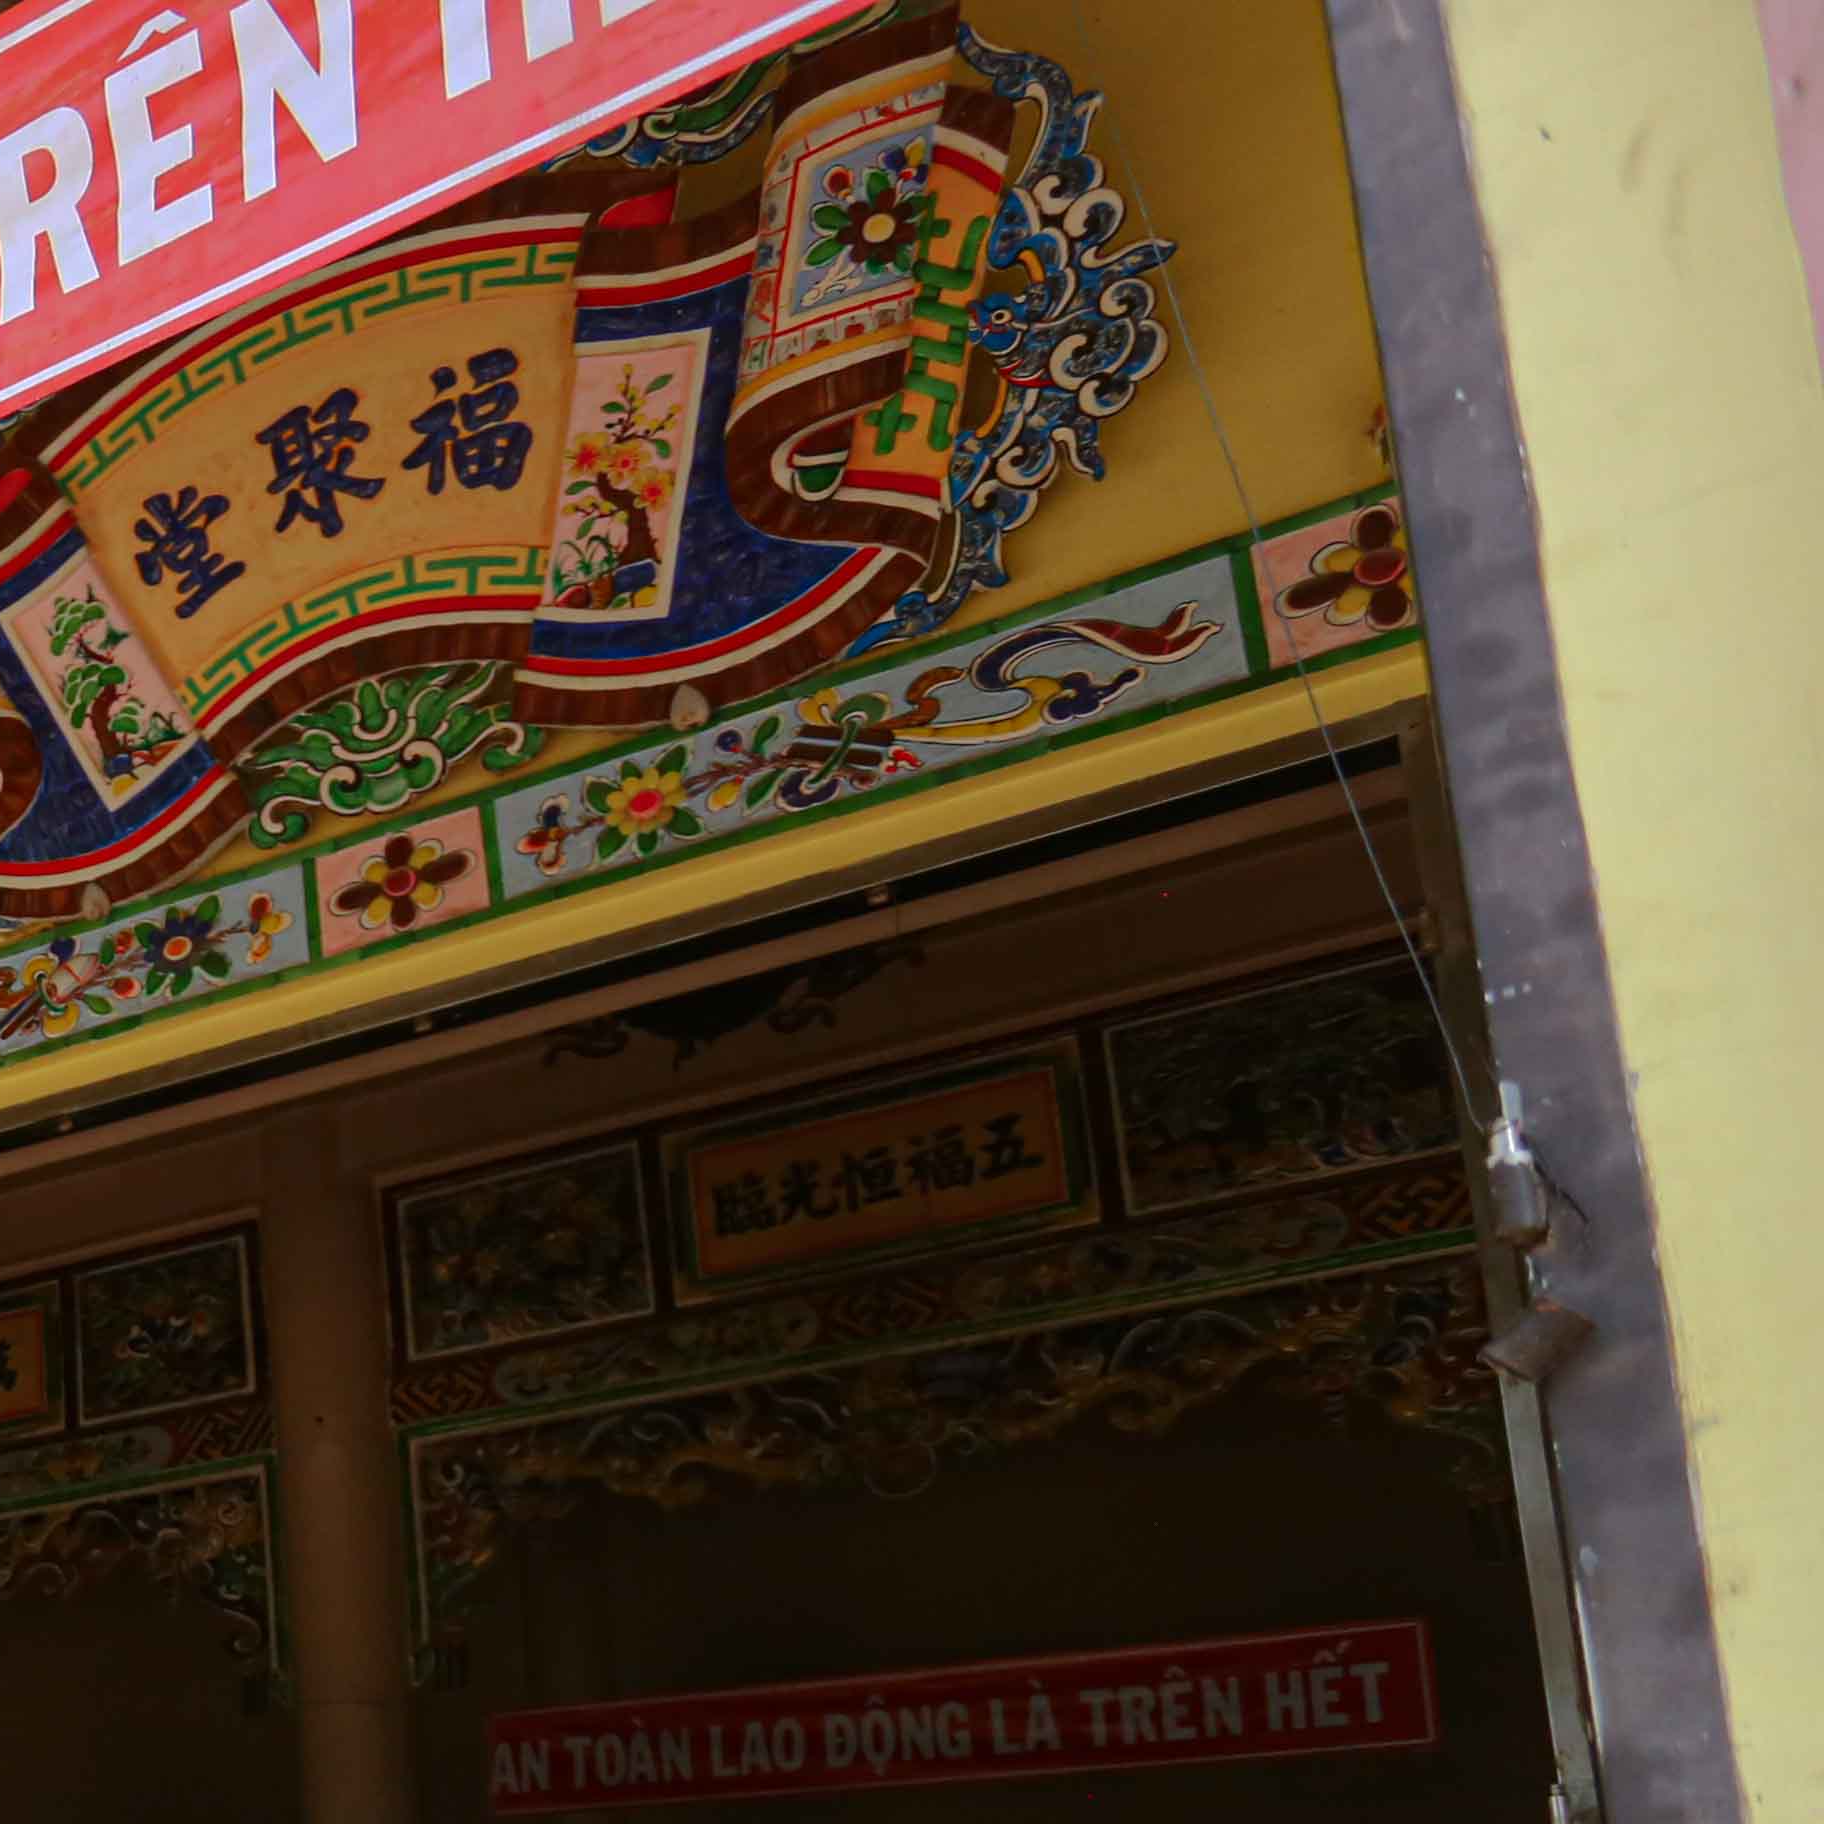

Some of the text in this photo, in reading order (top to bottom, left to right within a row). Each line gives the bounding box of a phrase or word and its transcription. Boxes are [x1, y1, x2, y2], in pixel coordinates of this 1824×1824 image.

[490, 1641, 1390, 1796] AN TOÀN LAO ĐỘNG LÀ TRÊN HẾT
